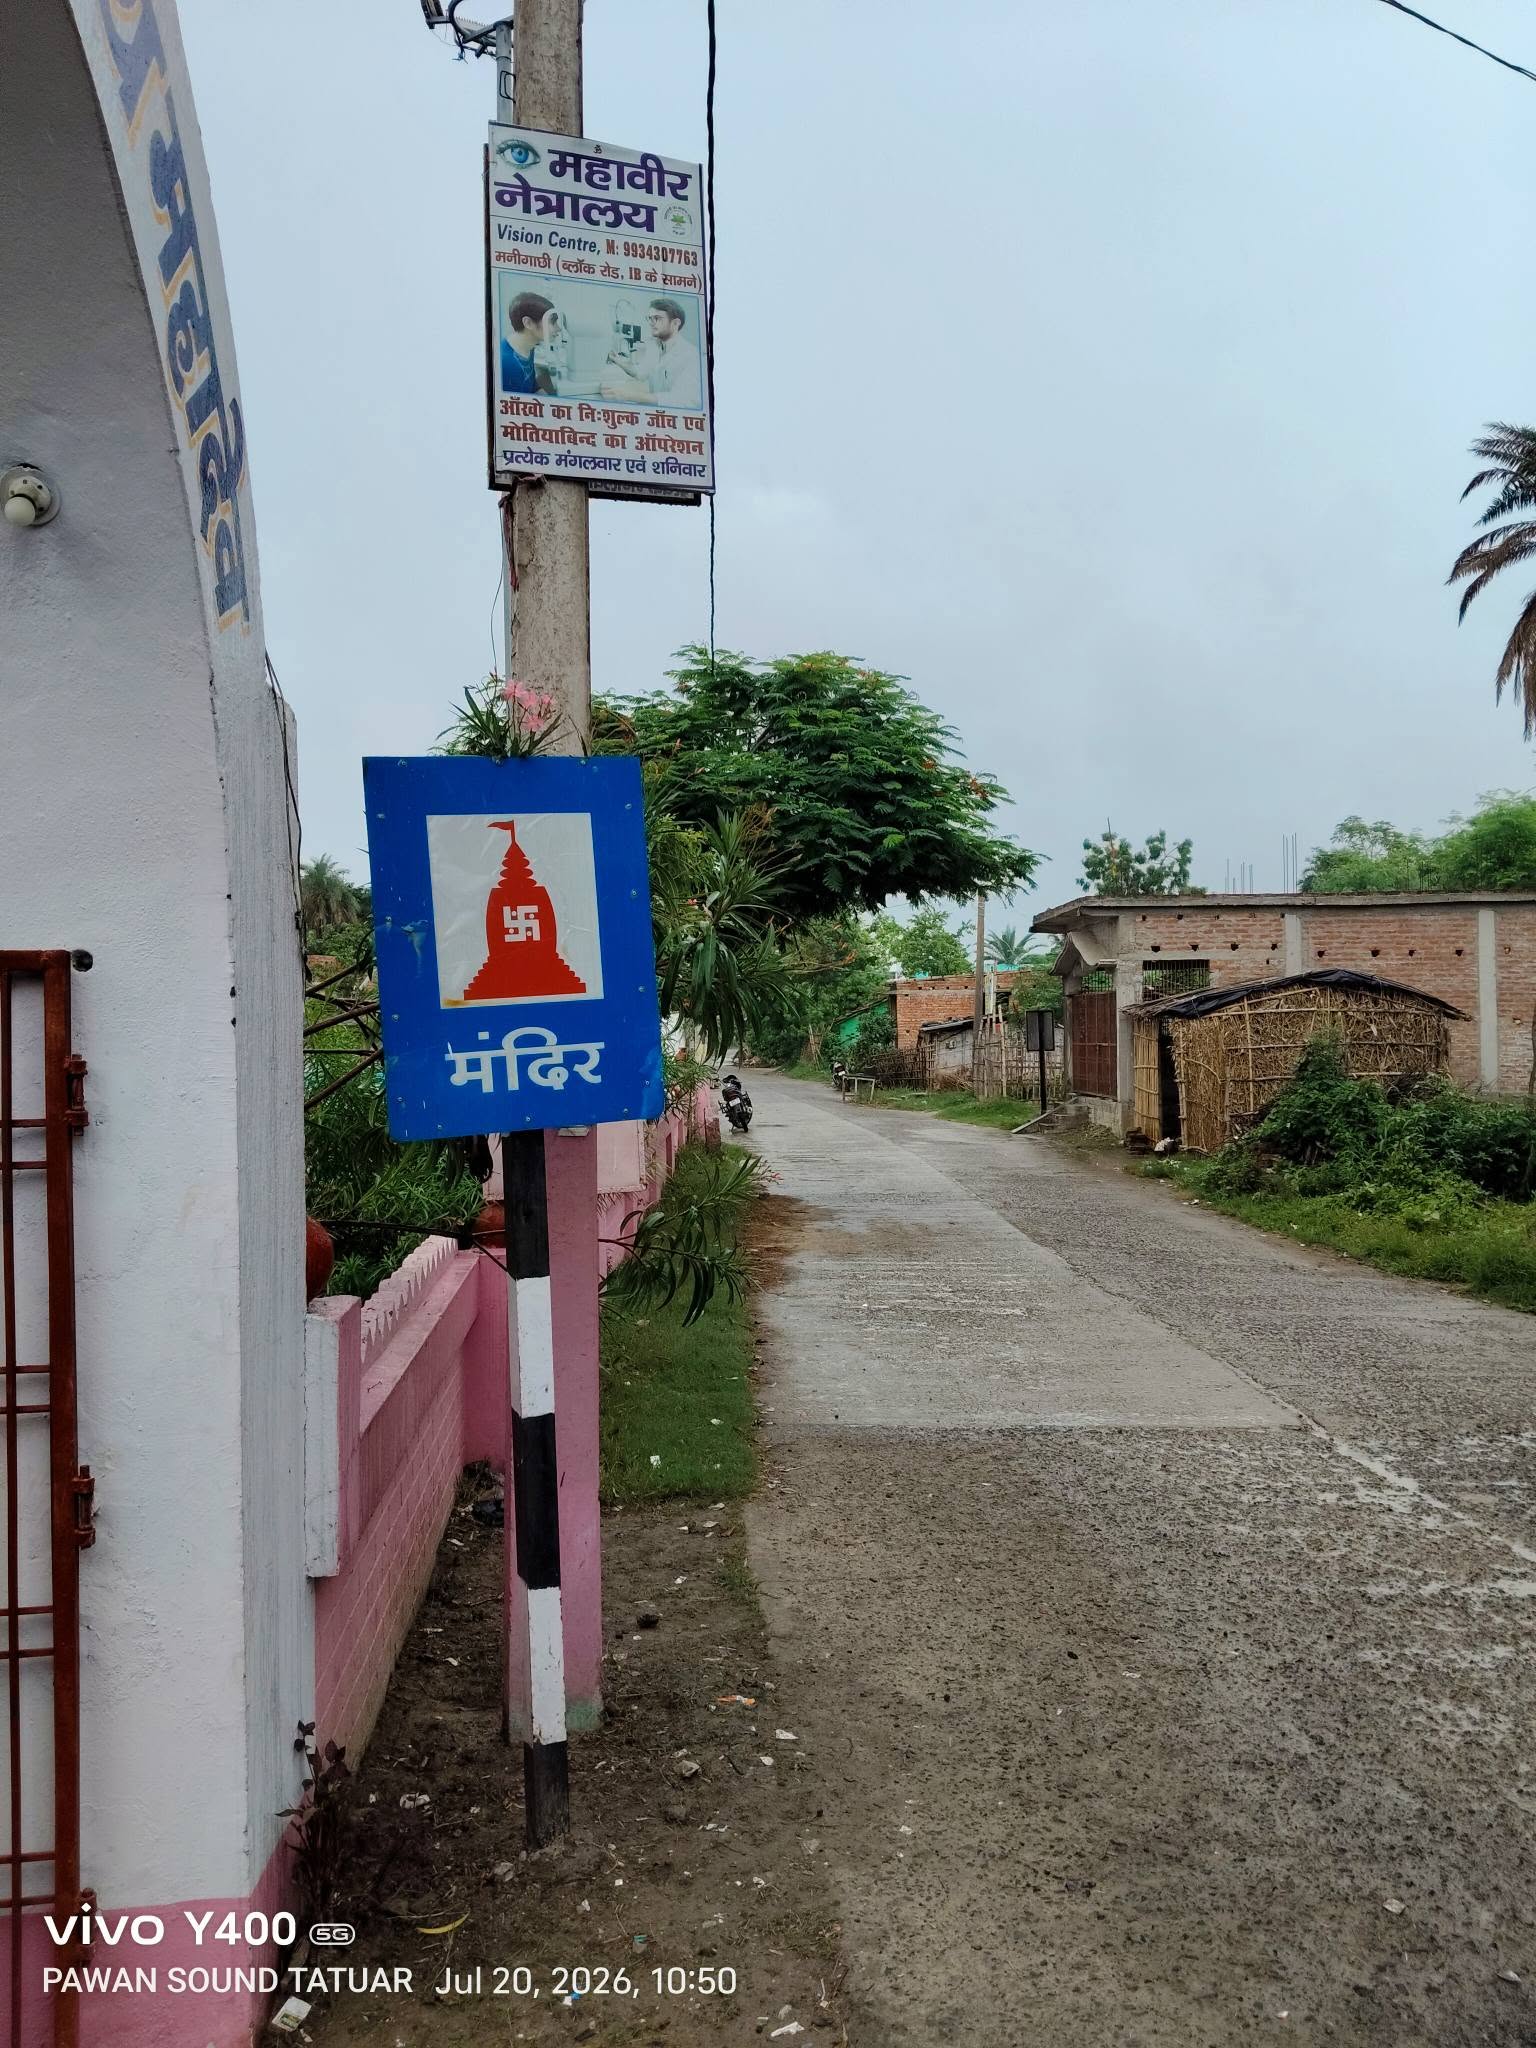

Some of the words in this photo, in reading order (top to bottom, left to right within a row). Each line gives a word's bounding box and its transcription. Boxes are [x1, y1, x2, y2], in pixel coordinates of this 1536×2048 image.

[548, 149, 693, 201] महावीर
[493, 172, 658, 233] नेत्रालय
[497, 223, 543, 246] Vision
[548, 231, 601, 255] Centre,
[606, 238, 620, 256] M:
[623, 241, 698, 267] 9934307763
[494, 248, 552, 270] मनीगाछी
[599, 261, 624, 280] रोड,
[628, 267, 642, 281] IB
[644, 268, 658, 283] के
[661, 272, 703, 294] सामने)
[500, 421, 598, 447] मोतियाबिन्द
[602, 433, 627, 450] का
[635, 432, 705, 456] ऑपरेशन
[550, 404, 573, 421] का
[683, 413, 707, 432] एवं
[502, 446, 551, 466] प्रत्येक
[555, 449, 622, 472] मंगलवार
[625, 454, 647, 474] एवं
[652, 456, 707, 478] शनिवार
[445, 1026, 605, 1094] मंदिर
